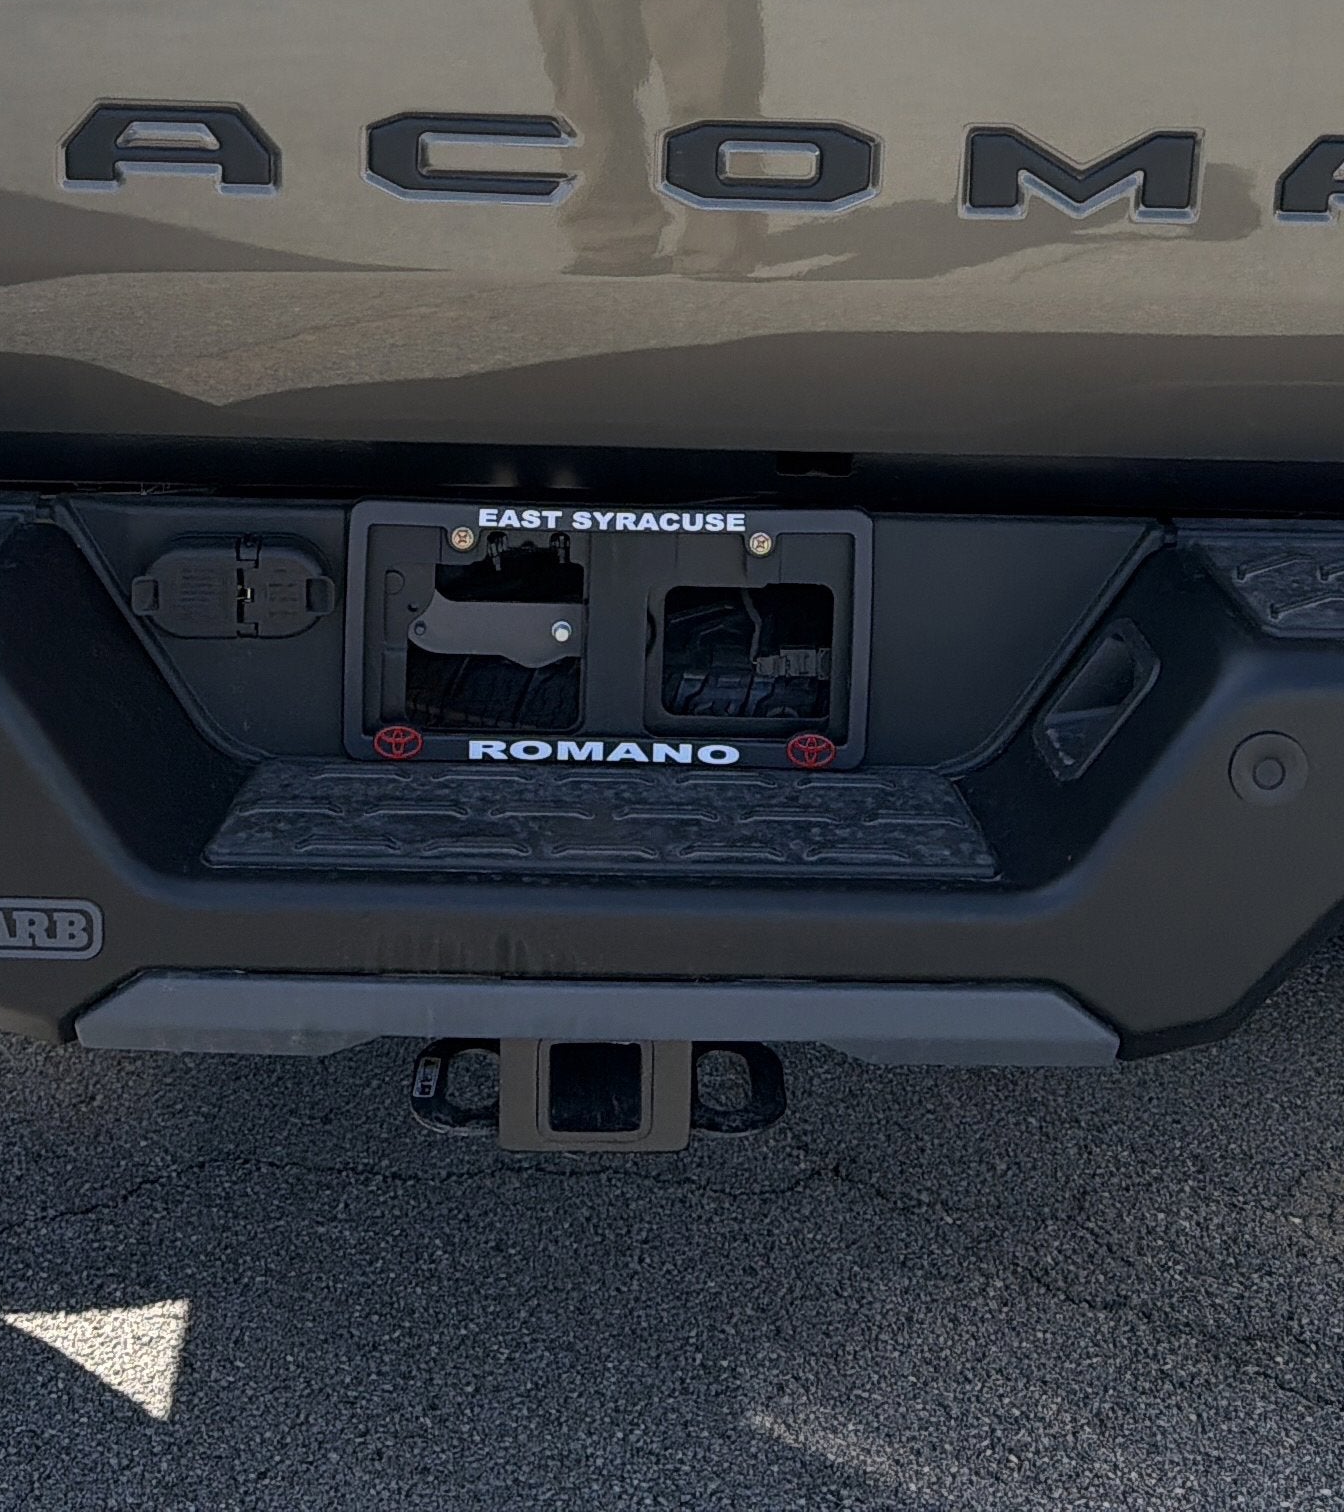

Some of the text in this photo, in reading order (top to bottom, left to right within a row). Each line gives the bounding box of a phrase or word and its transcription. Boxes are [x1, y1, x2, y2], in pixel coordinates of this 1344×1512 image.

[478, 508, 746, 533] EAST SYRACUSE
[468, 739, 740, 766] ROMANO
